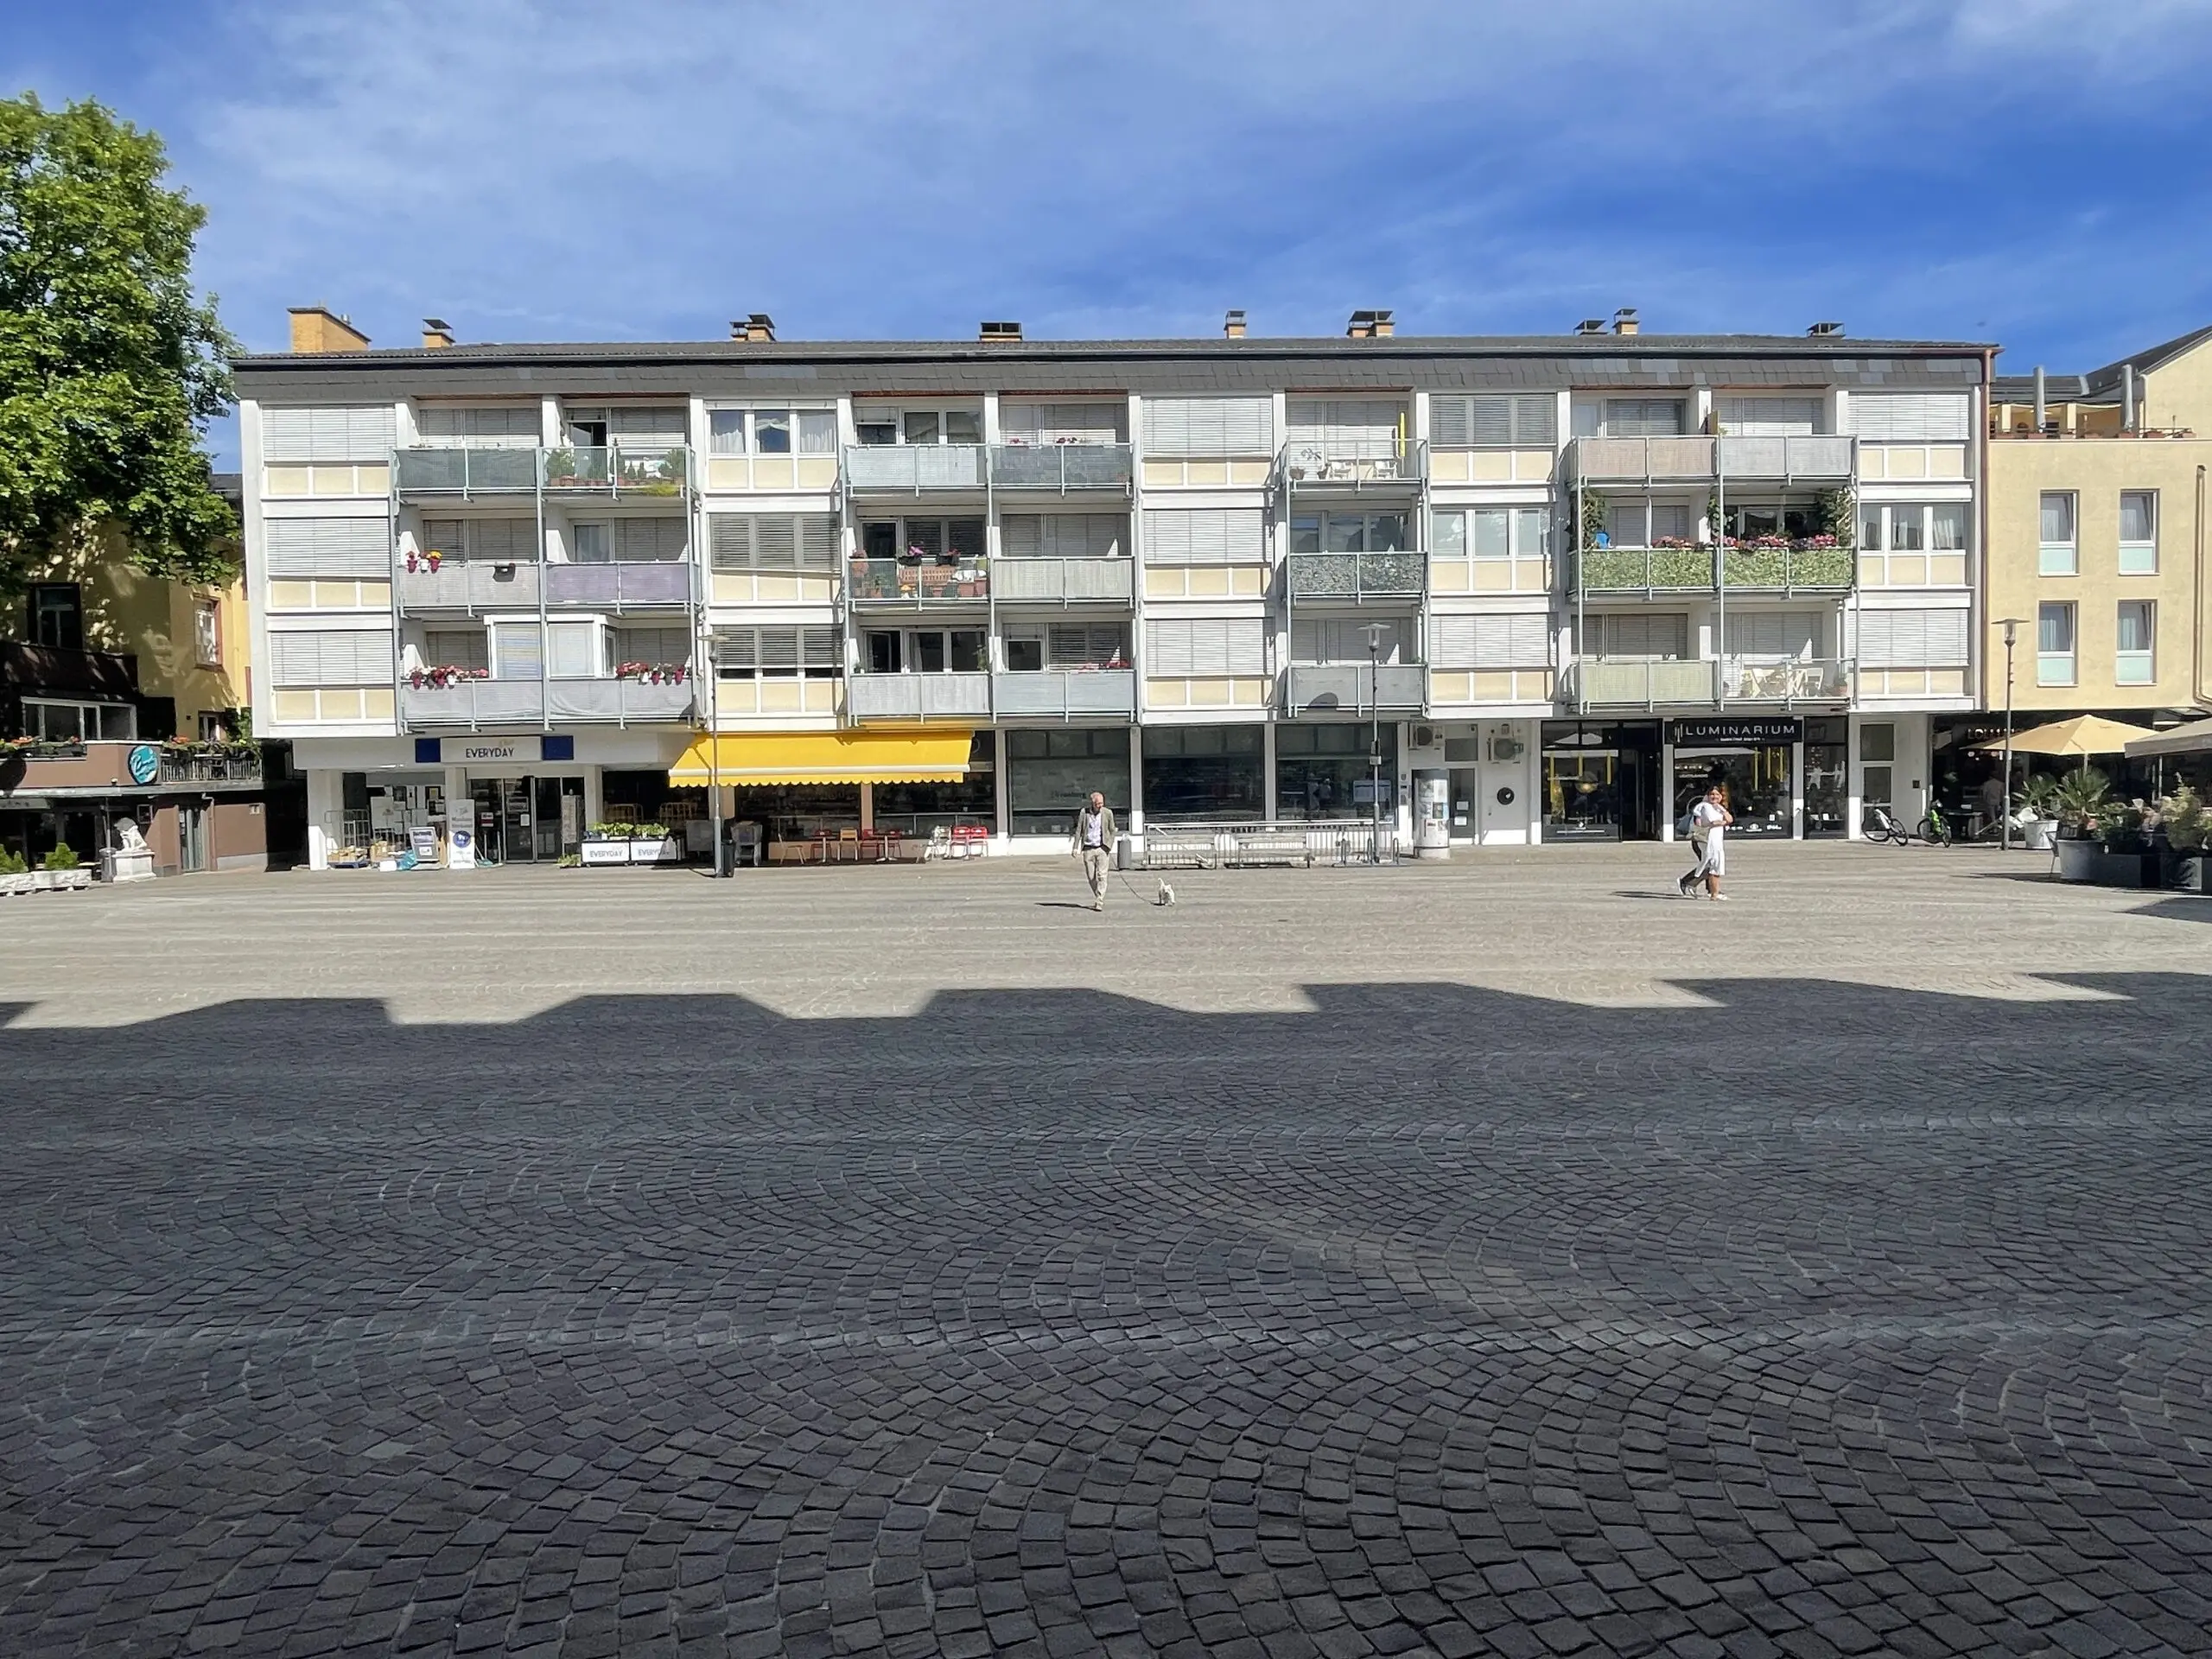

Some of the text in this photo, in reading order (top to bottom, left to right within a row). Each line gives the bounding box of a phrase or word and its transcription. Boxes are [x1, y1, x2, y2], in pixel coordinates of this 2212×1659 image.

[1686, 725, 1795, 735] LUMINARIUM
[466, 747, 514, 759] EVERYDAY
[589, 849, 623, 858] EVERYDAY
